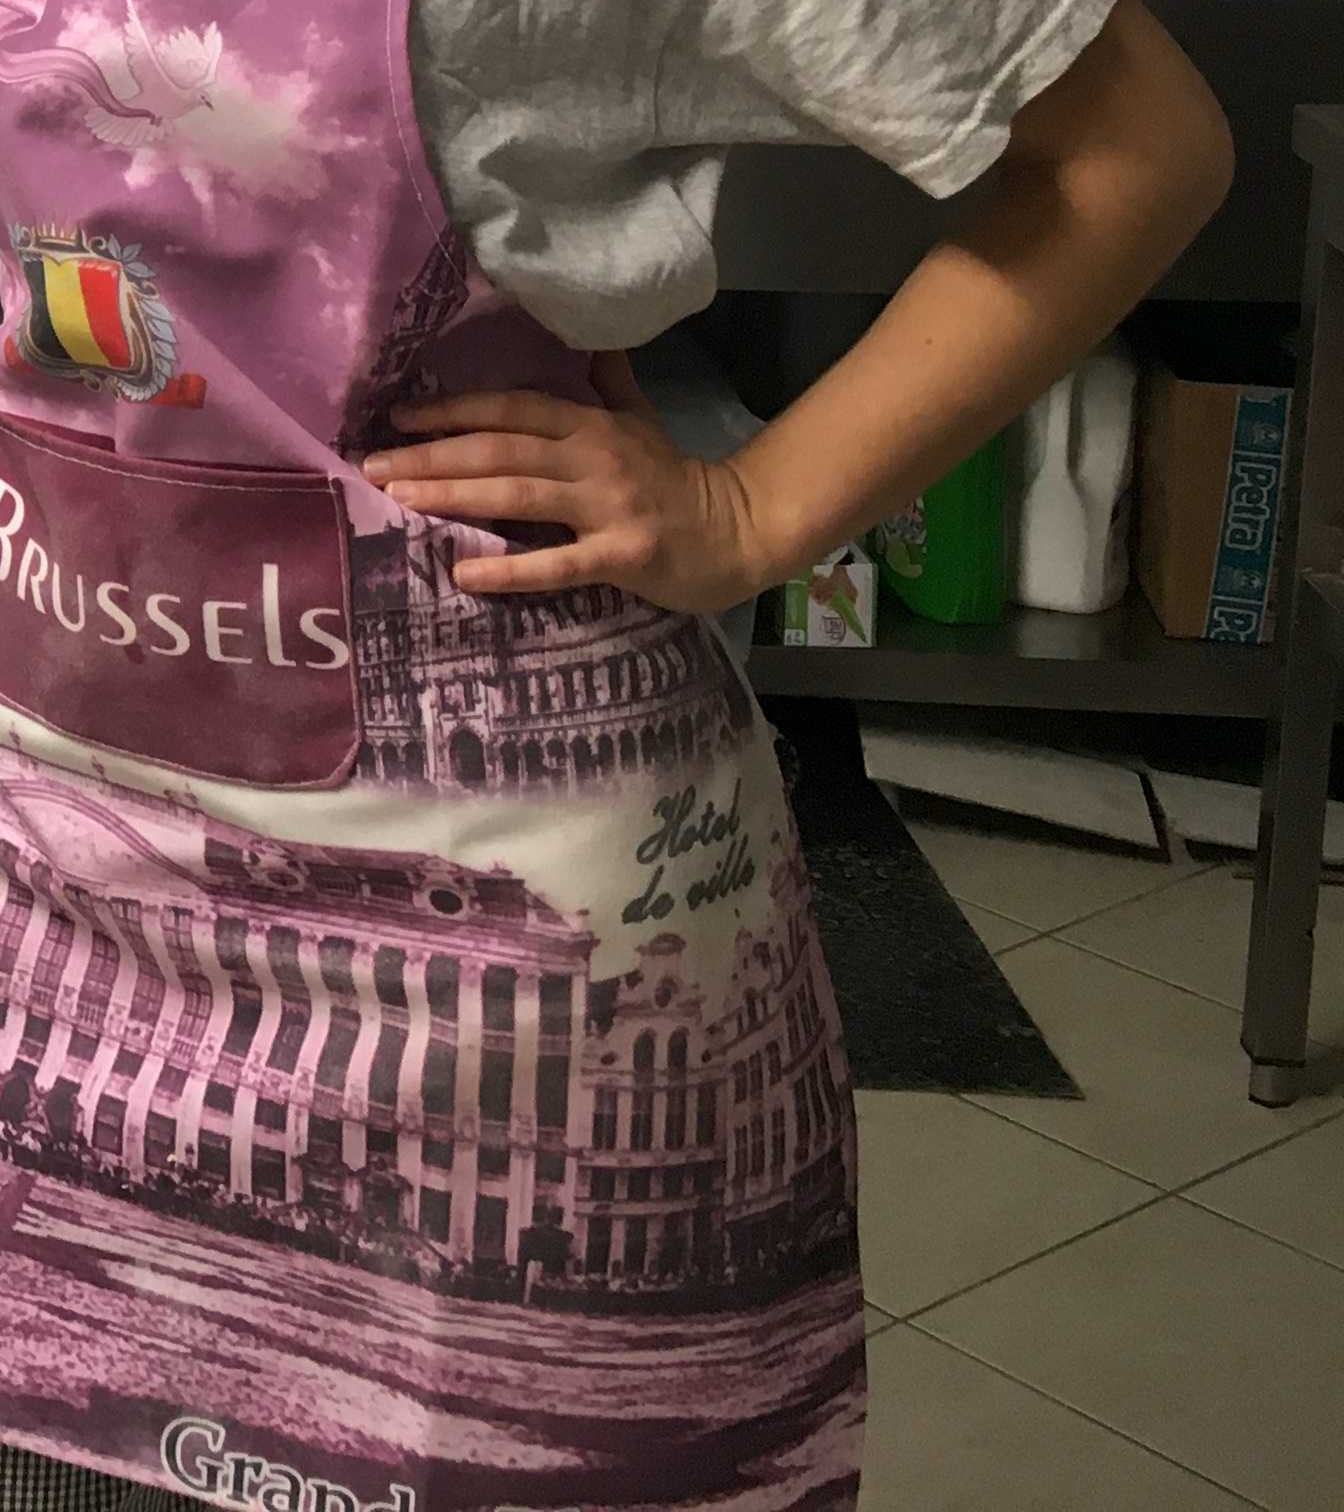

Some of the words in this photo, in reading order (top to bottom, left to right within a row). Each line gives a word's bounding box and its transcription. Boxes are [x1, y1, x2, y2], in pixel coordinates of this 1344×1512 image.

[1226, 459, 1277, 550] Petra
[637, 777, 742, 864] Hotel
[622, 865, 675, 924] de
[686, 833, 755, 911] ville
[159, 1416, 416, 1512] Grand
